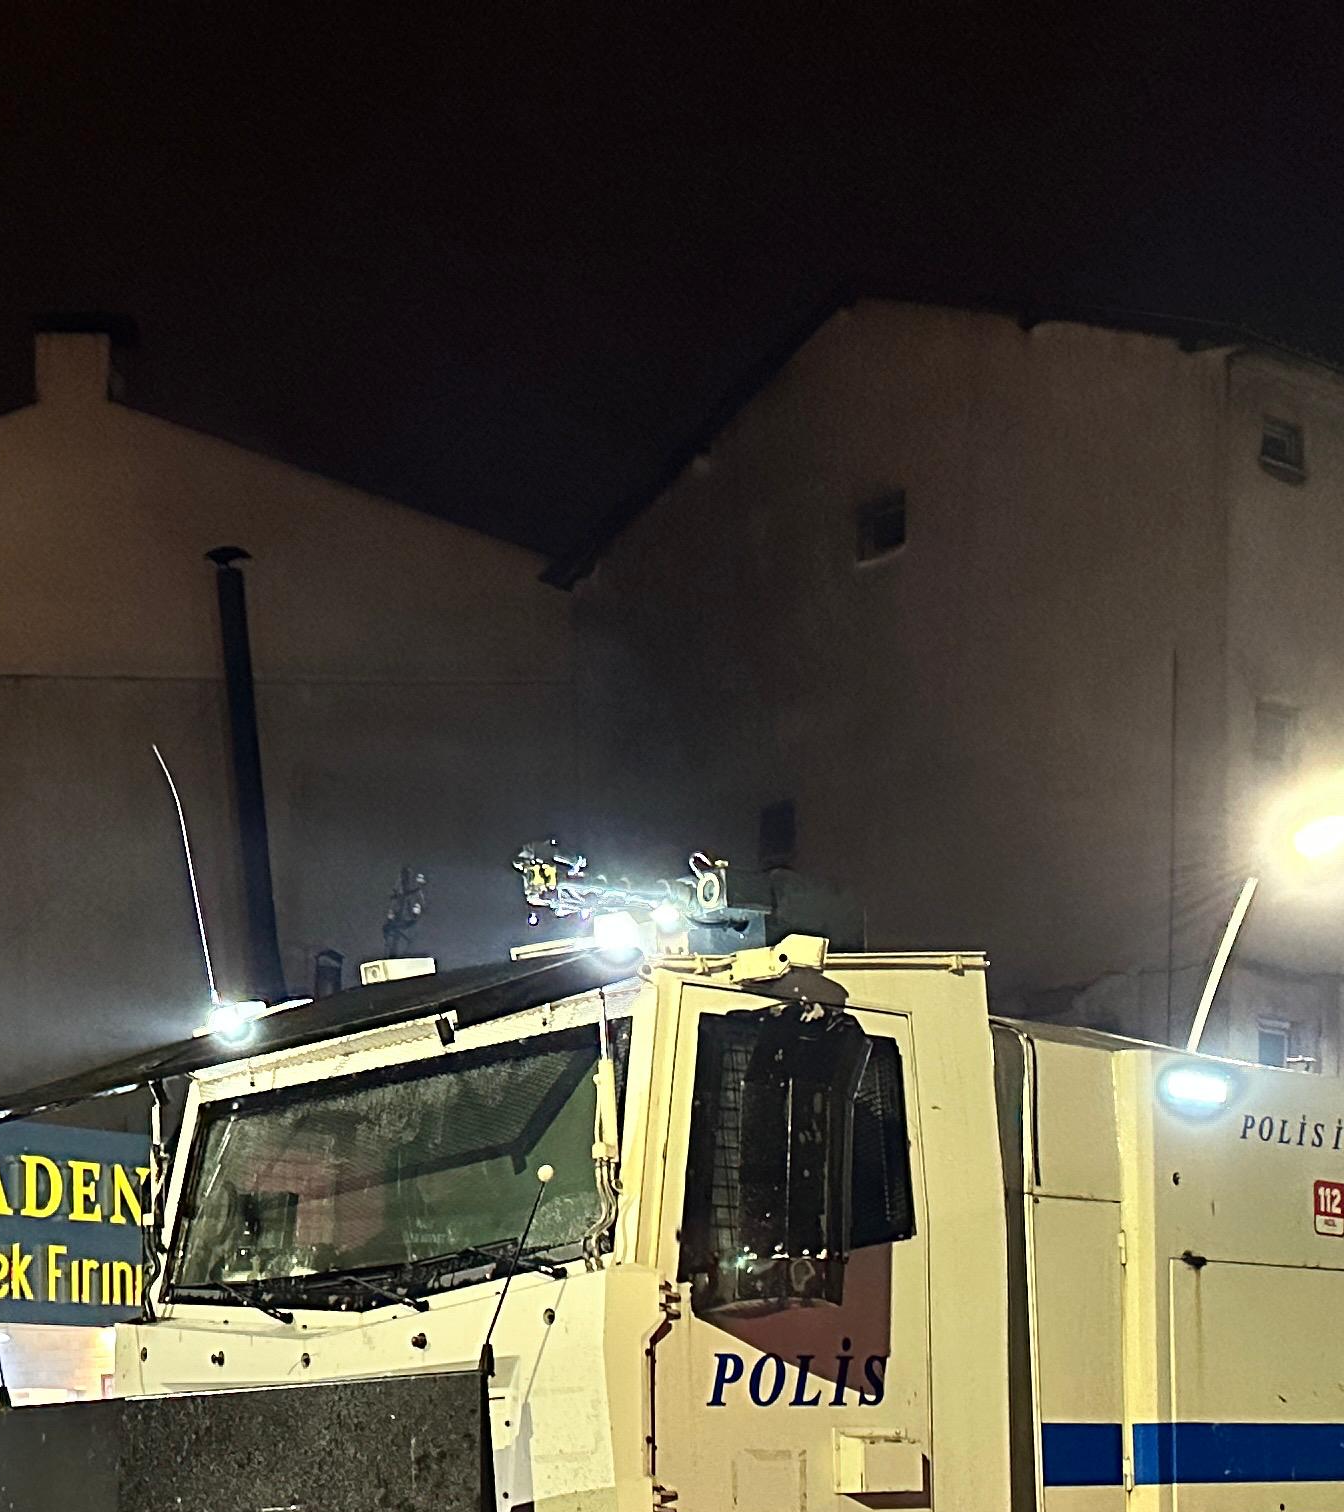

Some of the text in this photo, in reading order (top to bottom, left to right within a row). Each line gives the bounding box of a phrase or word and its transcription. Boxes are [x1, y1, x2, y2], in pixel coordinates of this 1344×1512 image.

[1240, 1114, 1325, 1149] POLİS
[1318, 1186, 1342, 1214] 112
[706, 1337, 888, 1407] POLİS
